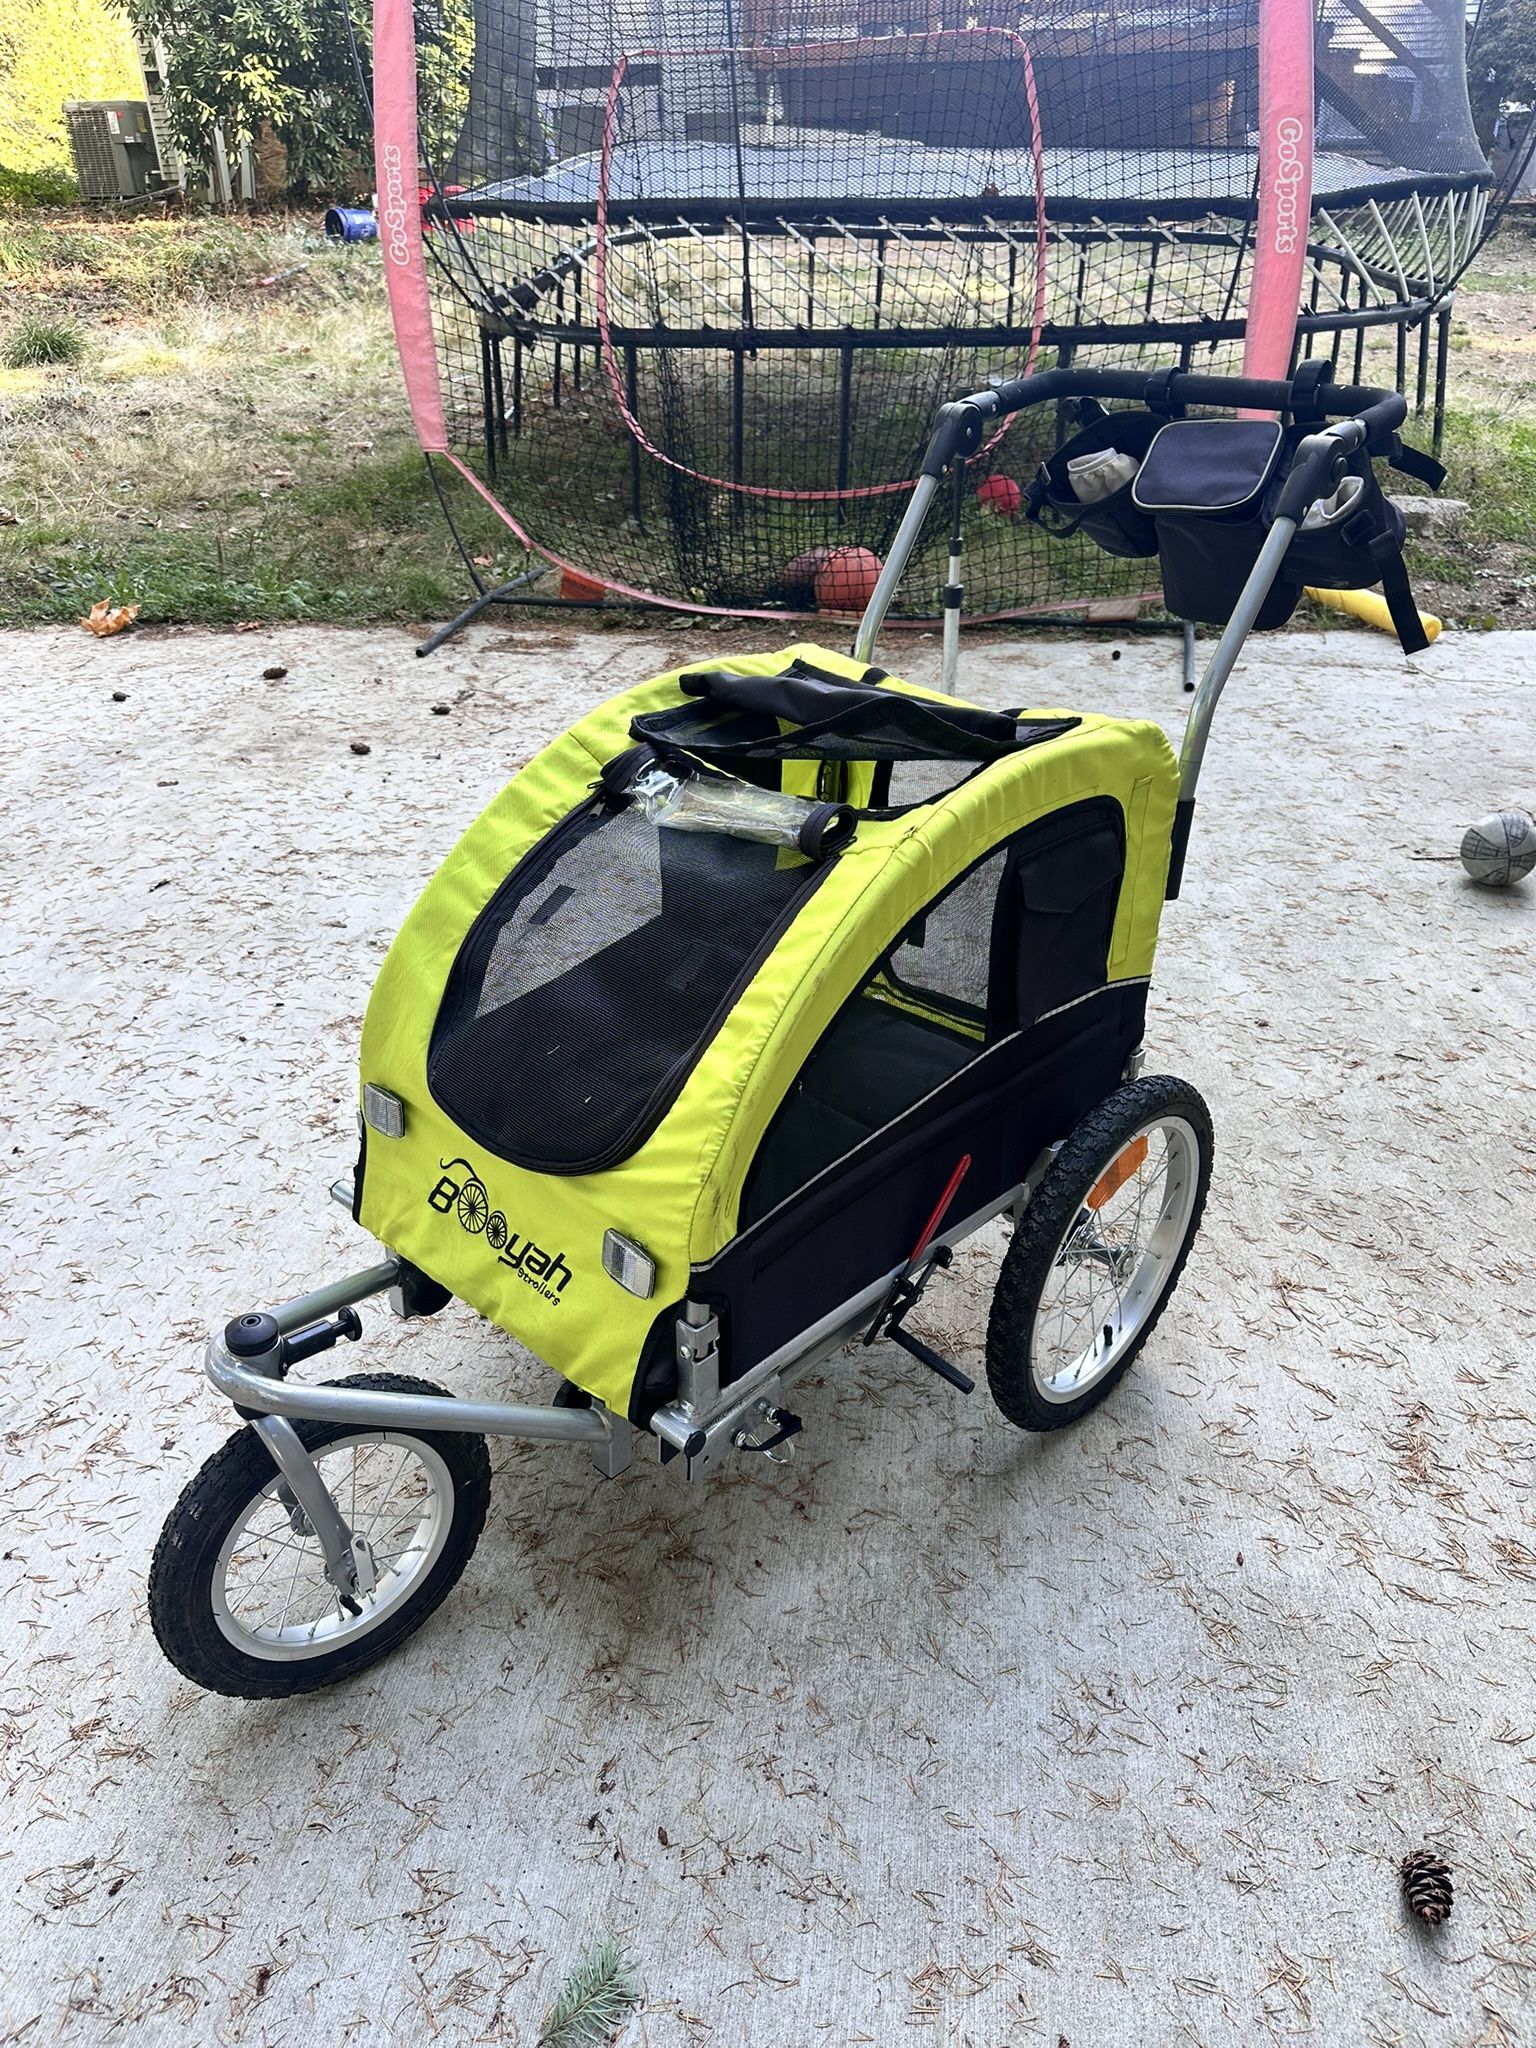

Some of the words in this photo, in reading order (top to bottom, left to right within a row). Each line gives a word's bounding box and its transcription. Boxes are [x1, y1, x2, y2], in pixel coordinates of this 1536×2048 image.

[383, 144, 410, 266] GoSports
[1274, 117, 1303, 254] GoSports
[427, 1174, 573, 1293] Booyah
